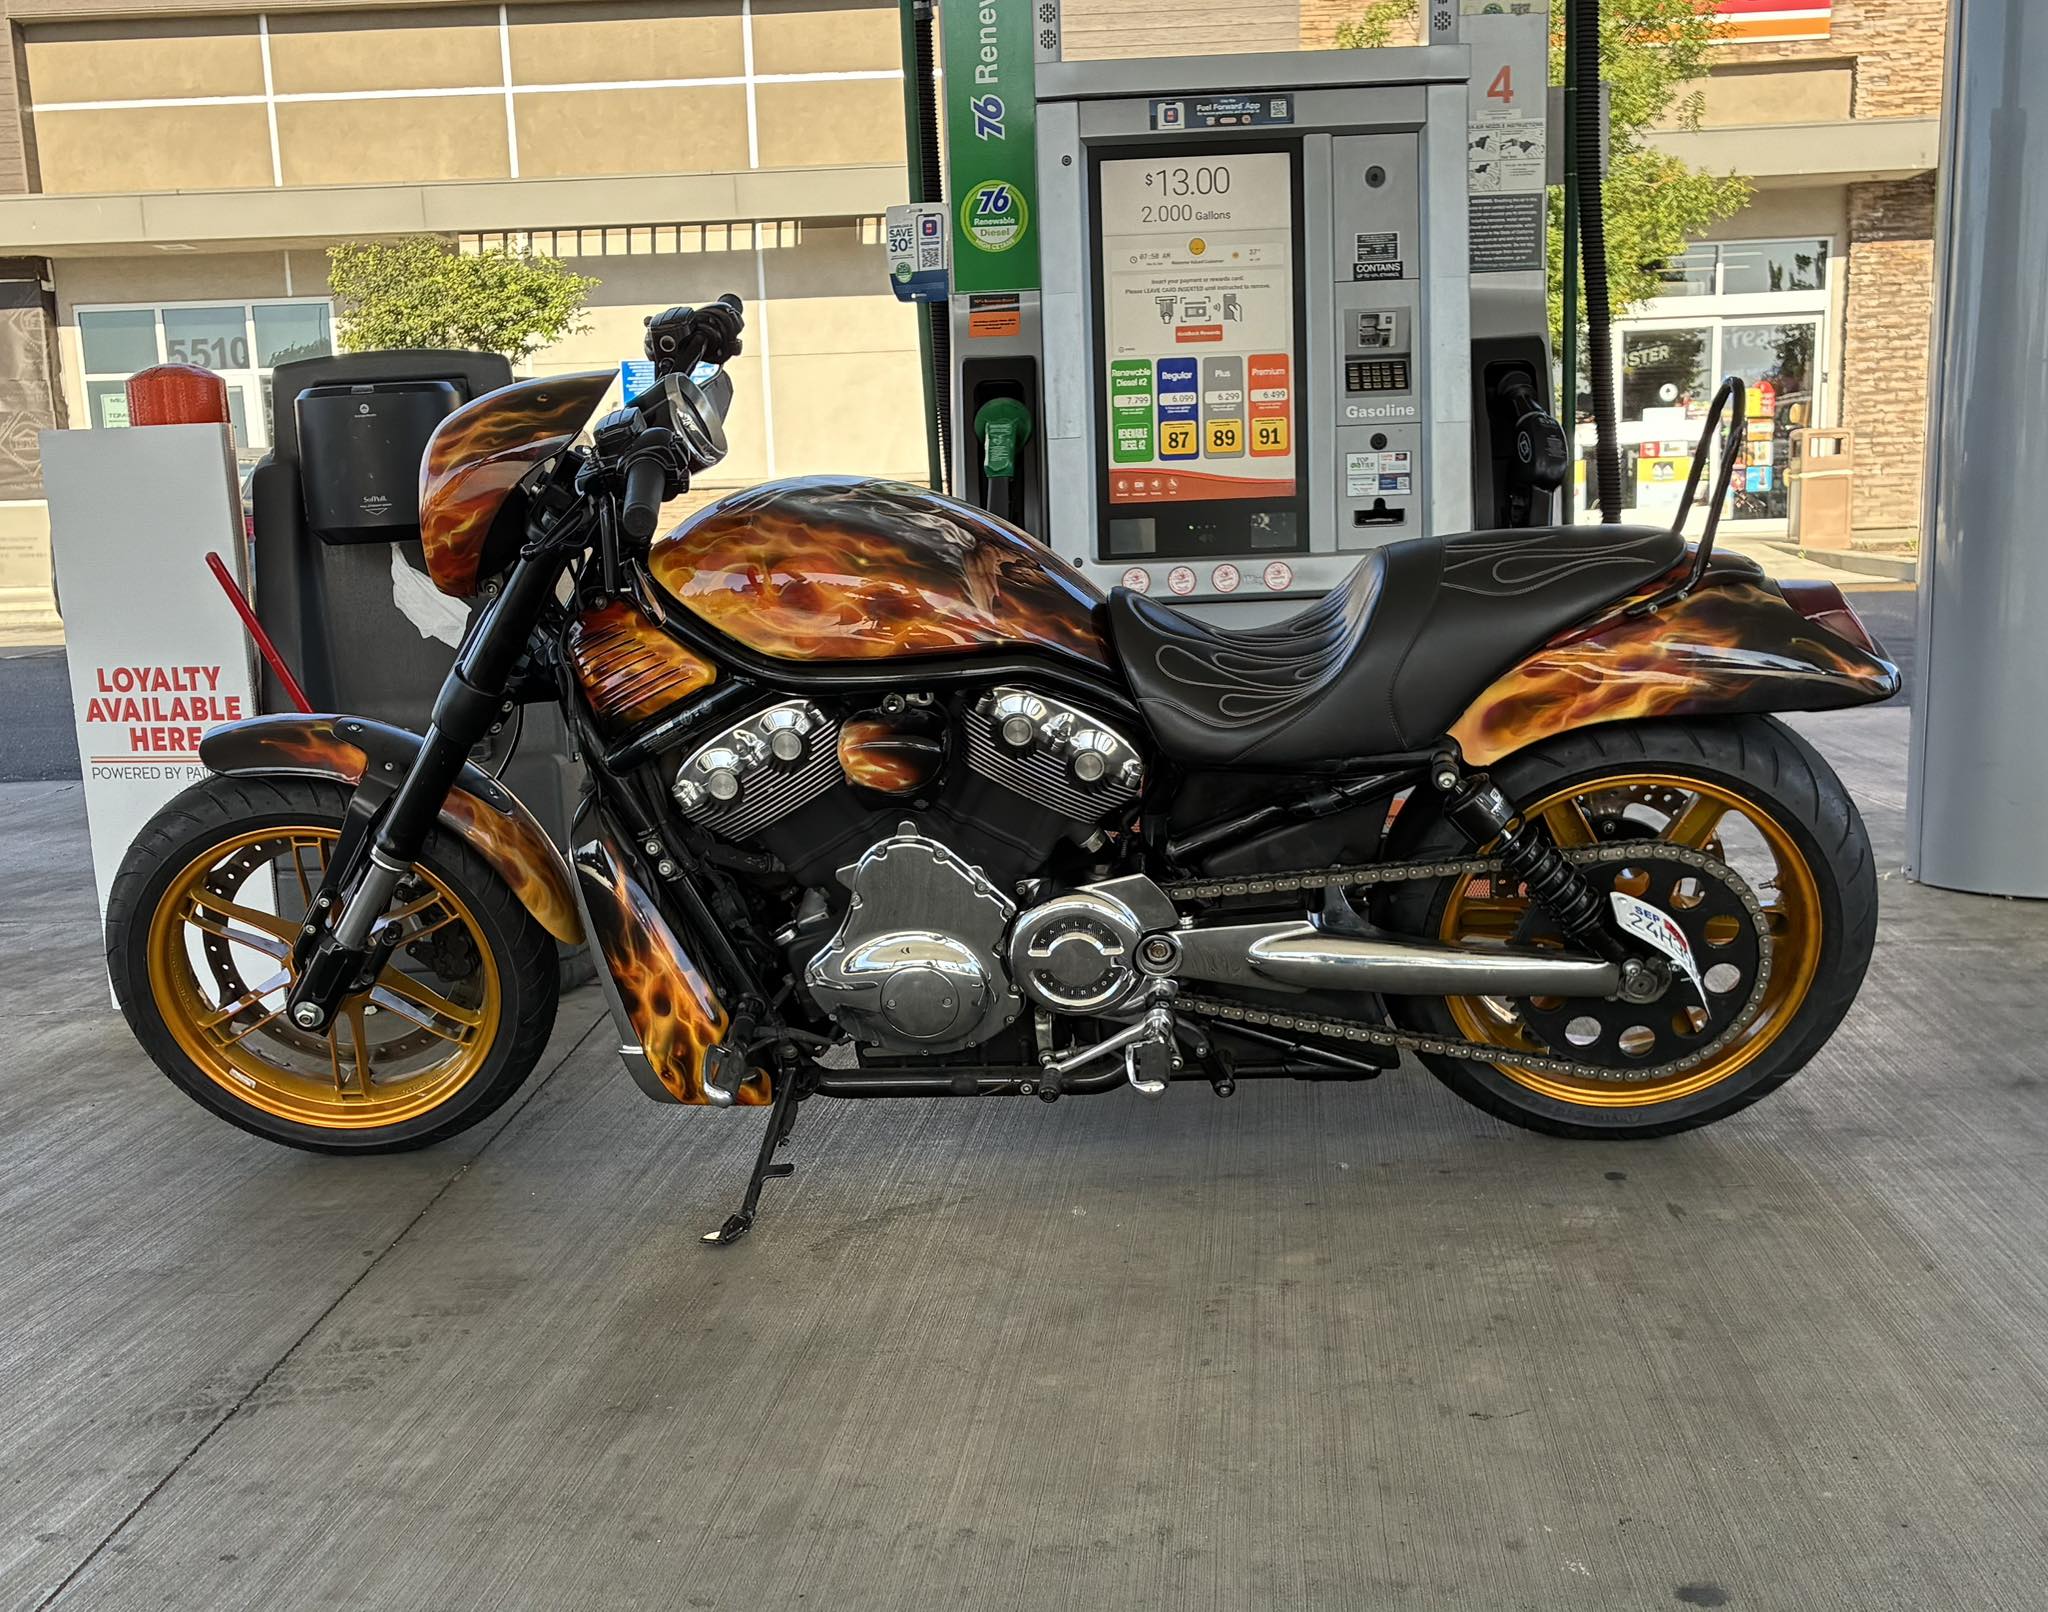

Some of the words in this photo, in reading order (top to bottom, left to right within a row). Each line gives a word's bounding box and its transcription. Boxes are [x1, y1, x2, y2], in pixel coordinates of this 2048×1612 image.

[1487, 65, 1513, 103] 4
[970, 94, 1005, 140] 76
[1145, 166, 1231, 197] $13.00
[976, 184, 1012, 214] 76
[973, 217, 1016, 226] Renewable
[1141, 204, 1193, 223] 2.000
[1195, 211, 1231, 222] Gallons
[889, 227, 913, 238] SAVE
[980, 227, 1010, 237] Diesel
[1355, 263, 1400, 272] CONTAINS
[168, 336, 248, 369] 5510
[1625, 345, 1670, 367] STER
[1161, 371, 1193, 382] Regular
[1214, 369, 1231, 378] Plus
[1251, 368, 1286, 376] Premium
[1172, 394, 1194, 402] 6.099
[1218, 392, 1240, 401] 6.299
[1263, 391, 1286, 399] 6.499
[1345, 404, 1415, 418] Gasoline
[1168, 431, 1190, 449] 87
[1213, 429, 1235, 447] 89
[1259, 427, 1281, 445] 91
[97, 666, 221, 693] LOYALTY
[86, 696, 242, 722] AVAILABLE
[129, 726, 203, 752] HERE
[92, 767, 161, 780] POWERED
[165, 767, 182, 780] BY
[1634, 905, 1661, 923] SEP
